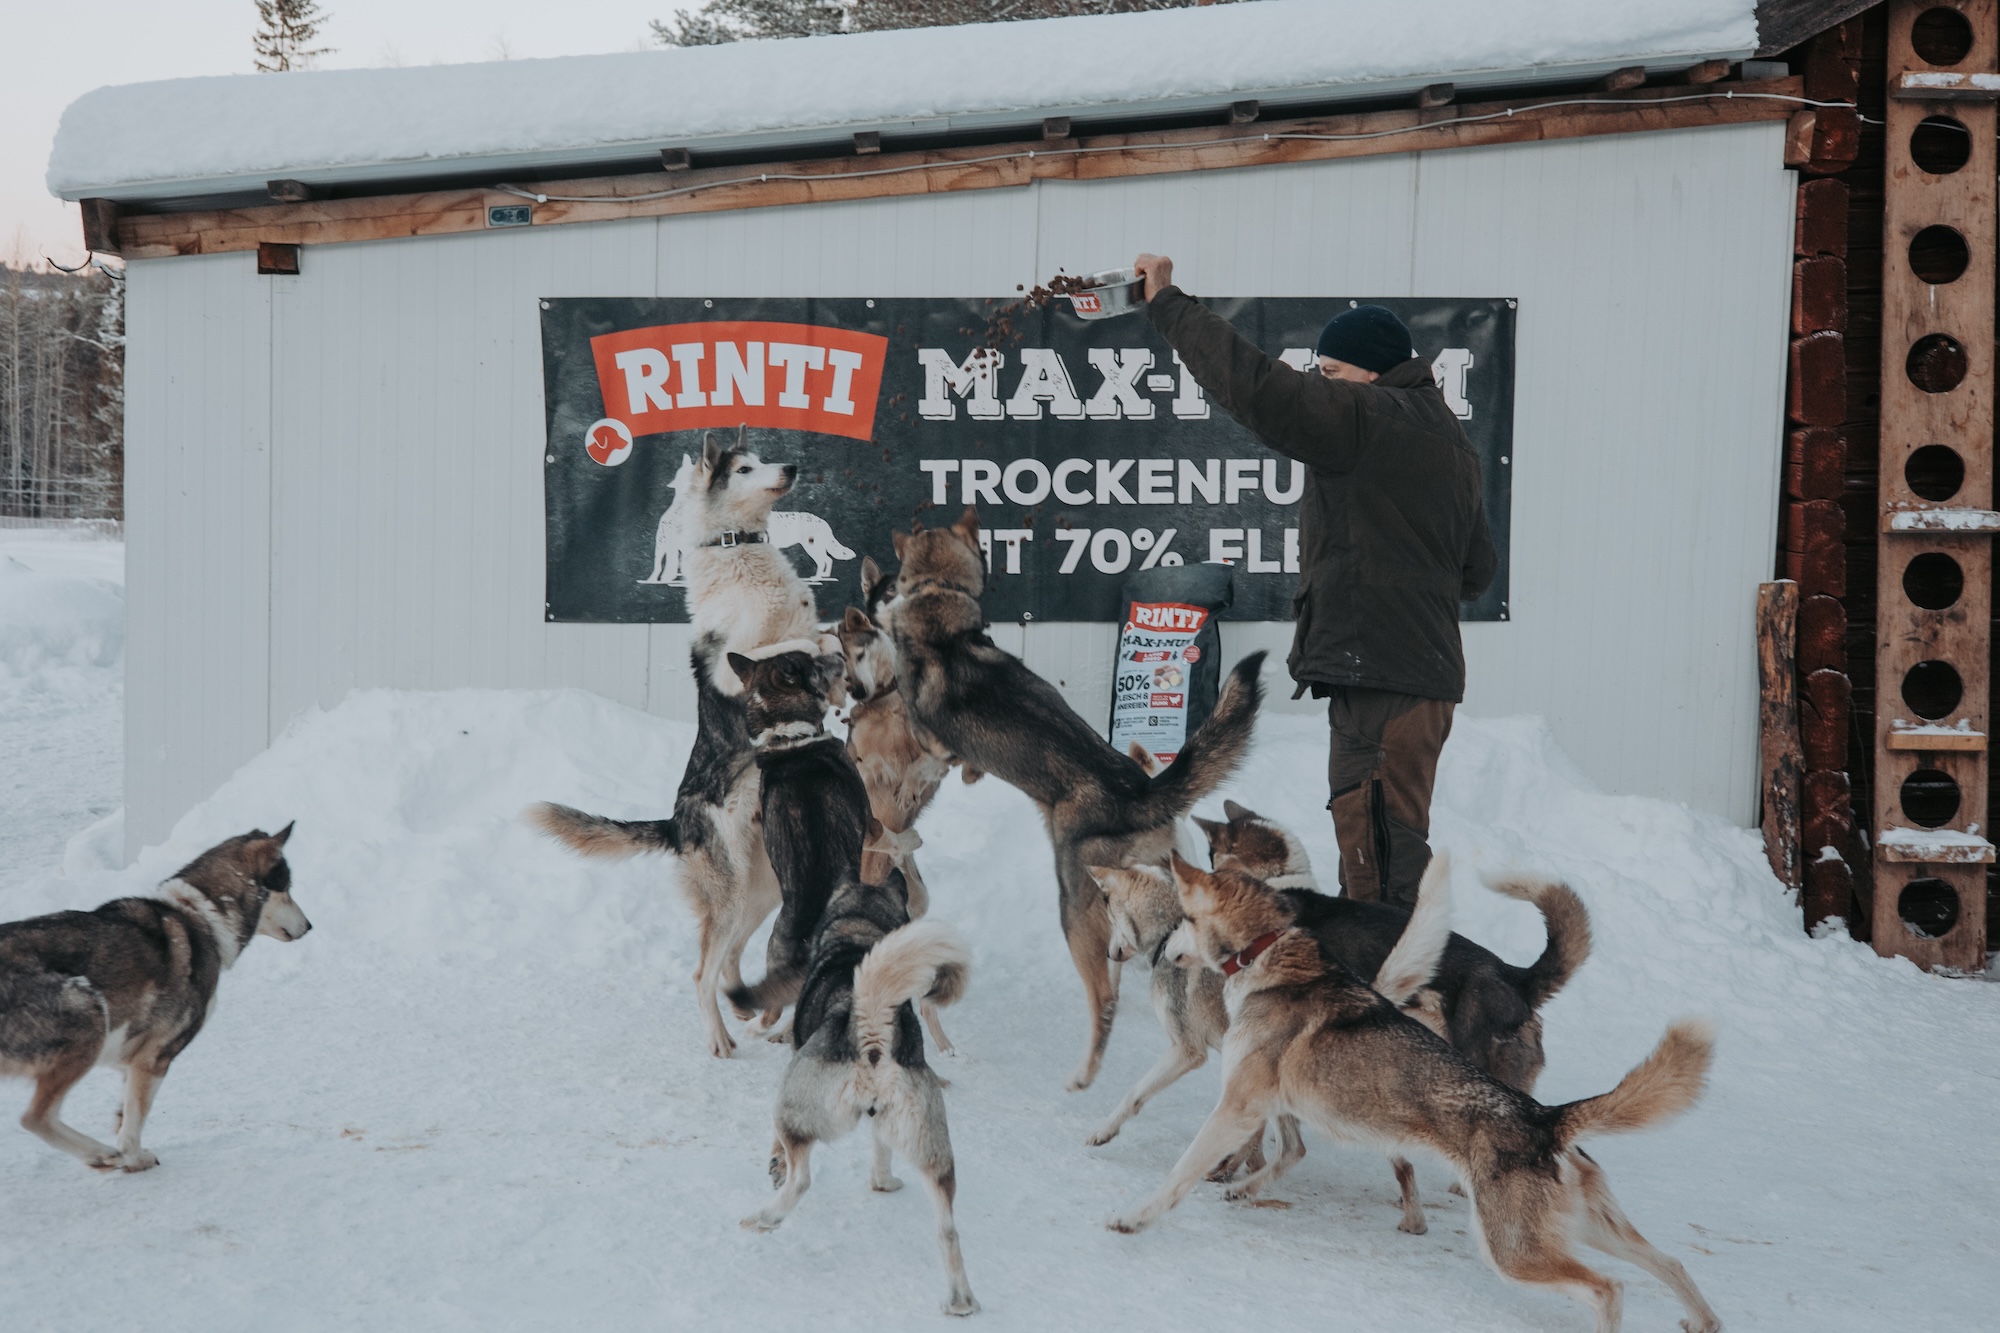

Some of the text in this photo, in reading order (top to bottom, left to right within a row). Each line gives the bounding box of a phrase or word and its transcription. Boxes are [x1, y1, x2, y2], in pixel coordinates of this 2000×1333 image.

[1072, 296, 1098, 310] NTI
[614, 340, 863, 416] RINTI
[920, 458, 1304, 505] TROCKENFU
[978, 528, 1300, 575] IT 70% FLE
[1135, 606, 1203, 629] RINTI
[1122, 635, 1191, 648] MAX-I-MU
[1117, 674, 1151, 693] 50%
